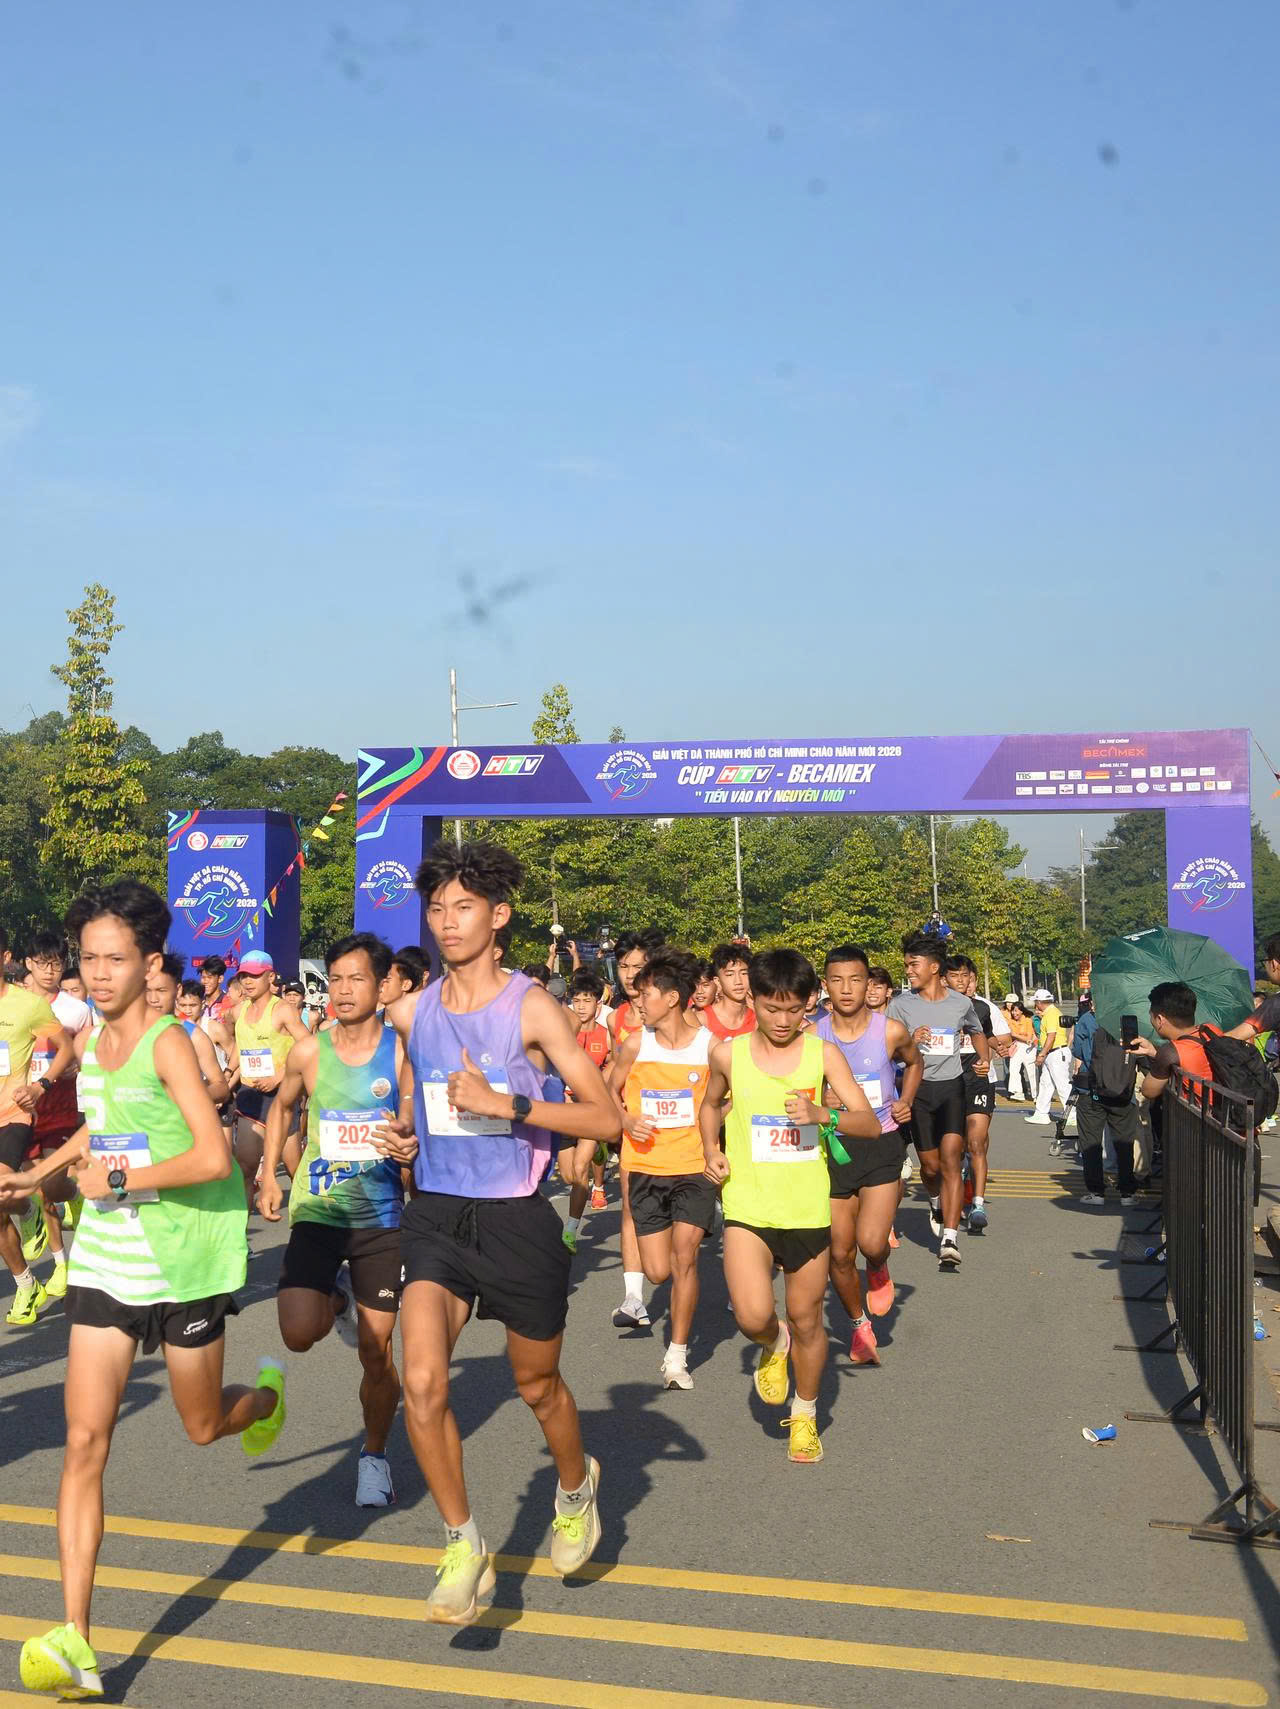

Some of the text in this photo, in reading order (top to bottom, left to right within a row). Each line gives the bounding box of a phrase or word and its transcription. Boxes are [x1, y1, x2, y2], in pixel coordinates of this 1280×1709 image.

[671, 748, 688, 761] VIỆT
[704, 748, 733, 759] THÀNH
[784, 747, 808, 758] MINH
[486, 758, 539, 771] HTV
[677, 762, 715, 785] CÚP
[718, 767, 771, 781] HTV
[787, 763, 876, 783] BECAMEX
[930, 1036, 944, 1046] 24
[248, 1056, 262, 1068] 199
[656, 1100, 678, 1115] 192
[974, 1094, 988, 1108] 49
[338, 1124, 370, 1144] 202
[770, 1128, 800, 1146] 240
